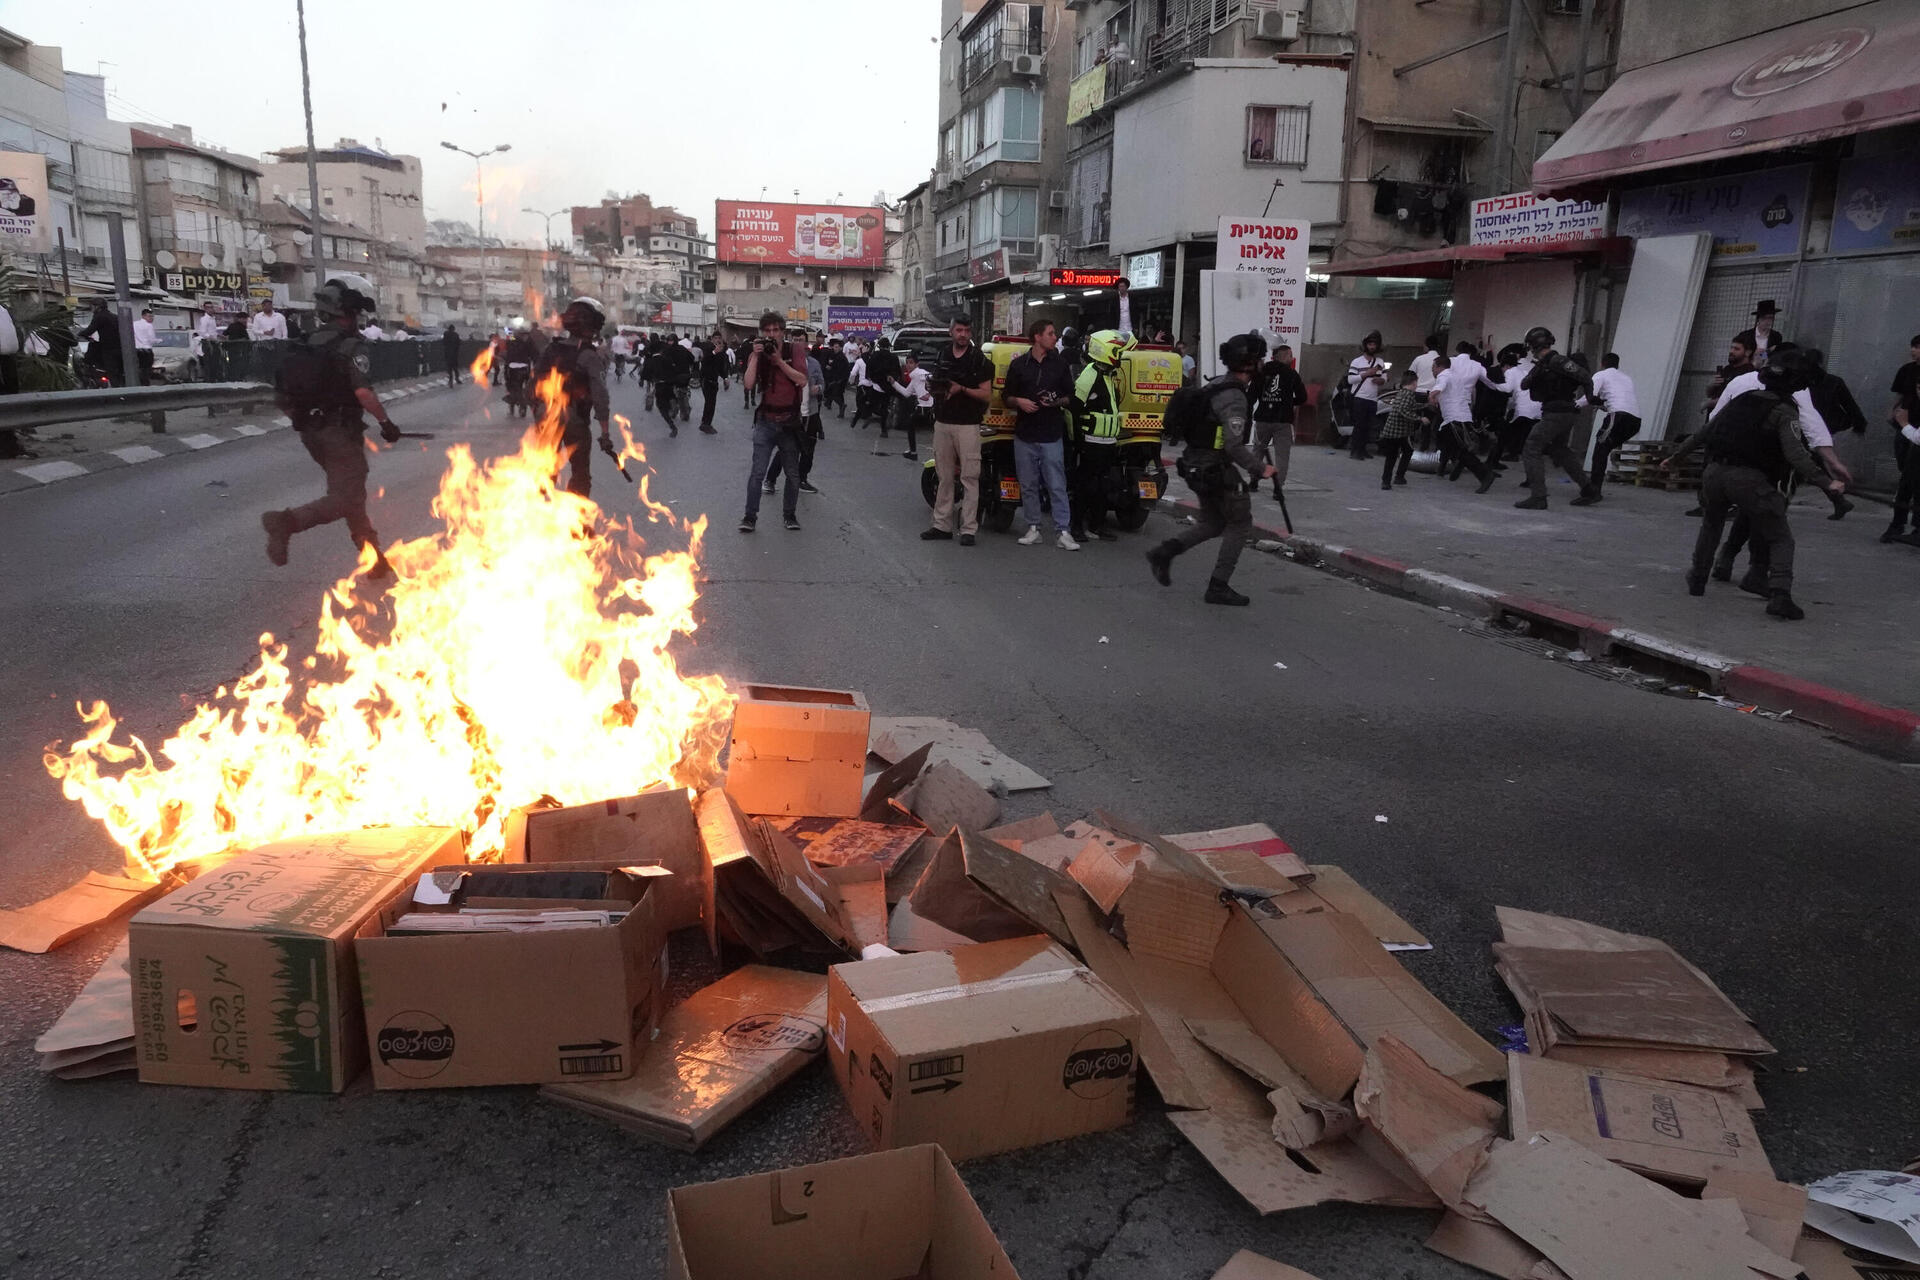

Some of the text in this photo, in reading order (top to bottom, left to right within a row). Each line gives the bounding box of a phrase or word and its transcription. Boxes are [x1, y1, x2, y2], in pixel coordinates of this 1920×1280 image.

[1477, 194, 1536, 214] הובלות
[737, 208, 774, 220] עוגיות
[730, 220, 780, 231] מזרחיות
[1535, 221, 1554, 233] לכל
[1560, 215, 1599, 230] הובלות
[762, 233, 784, 243] הטעם
[1230, 223, 1299, 241] מסגריית
[1506, 226, 1530, 238] חלקי
[1240, 242, 1286, 260] אליהו
[169, 278, 181, 286] 85
[184, 273, 242, 290] שלטים
[1063, 271, 1074, 283] 30
[1075, 274, 1111, 284] משפחתית
[1276, 307, 1285, 315] כל
[872, 316, 881, 324] לנו
[803, 711, 810, 720] 3
[149, 958, 168, 1063] 09-8943684
[803, 1180, 815, 1197] 2
